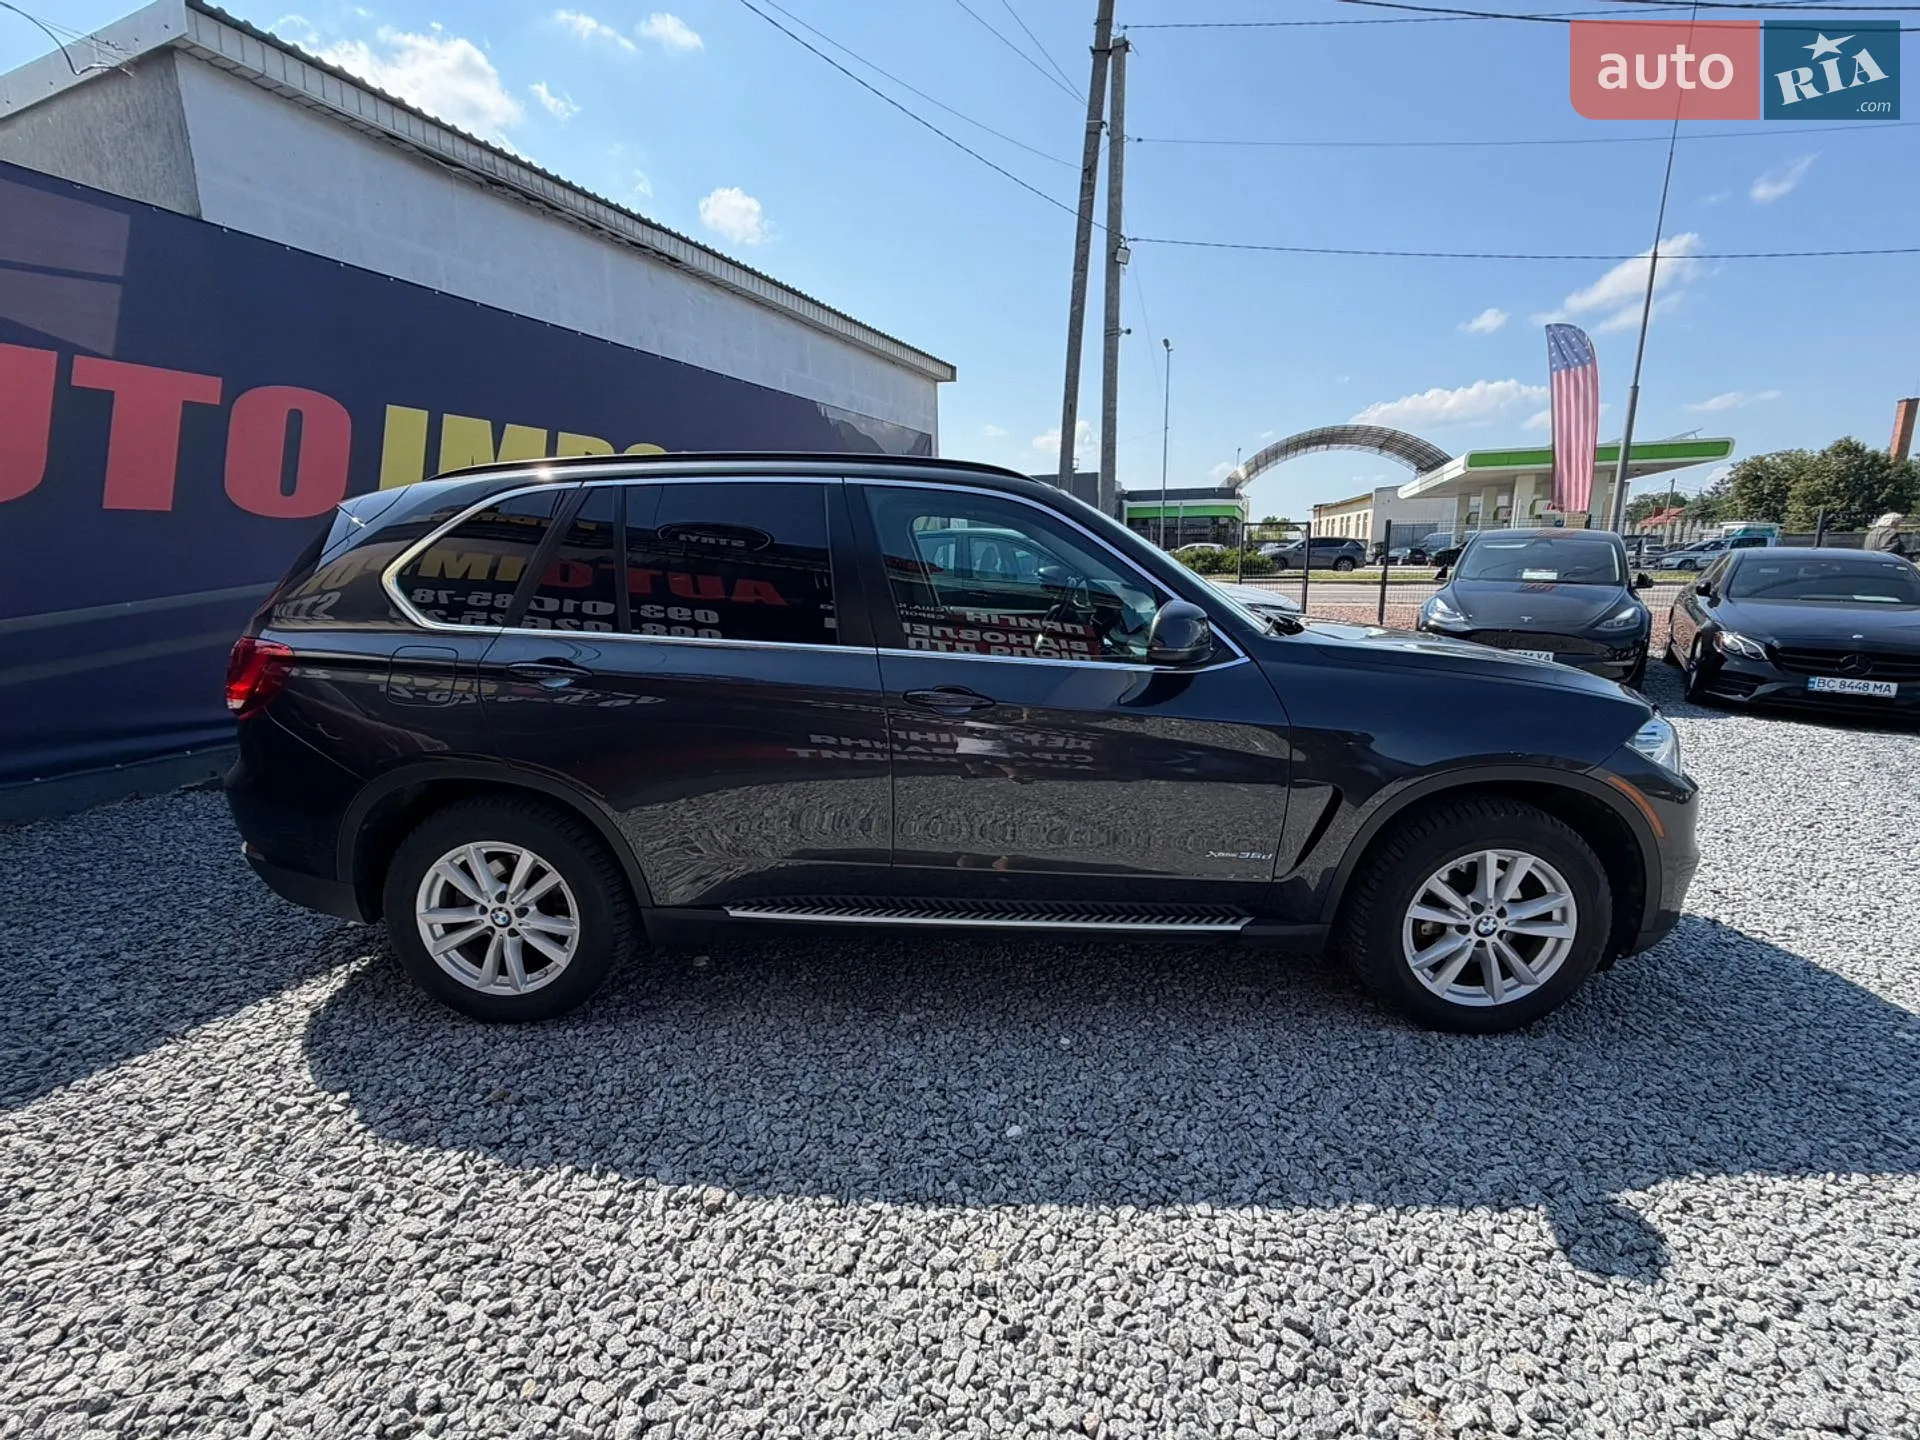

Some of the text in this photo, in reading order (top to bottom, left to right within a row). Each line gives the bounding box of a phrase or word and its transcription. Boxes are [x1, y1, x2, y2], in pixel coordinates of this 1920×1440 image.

[1817, 679, 1836, 689] BC
[1839, 680, 1869, 692] 8448
[1873, 683, 1892, 693] MA
